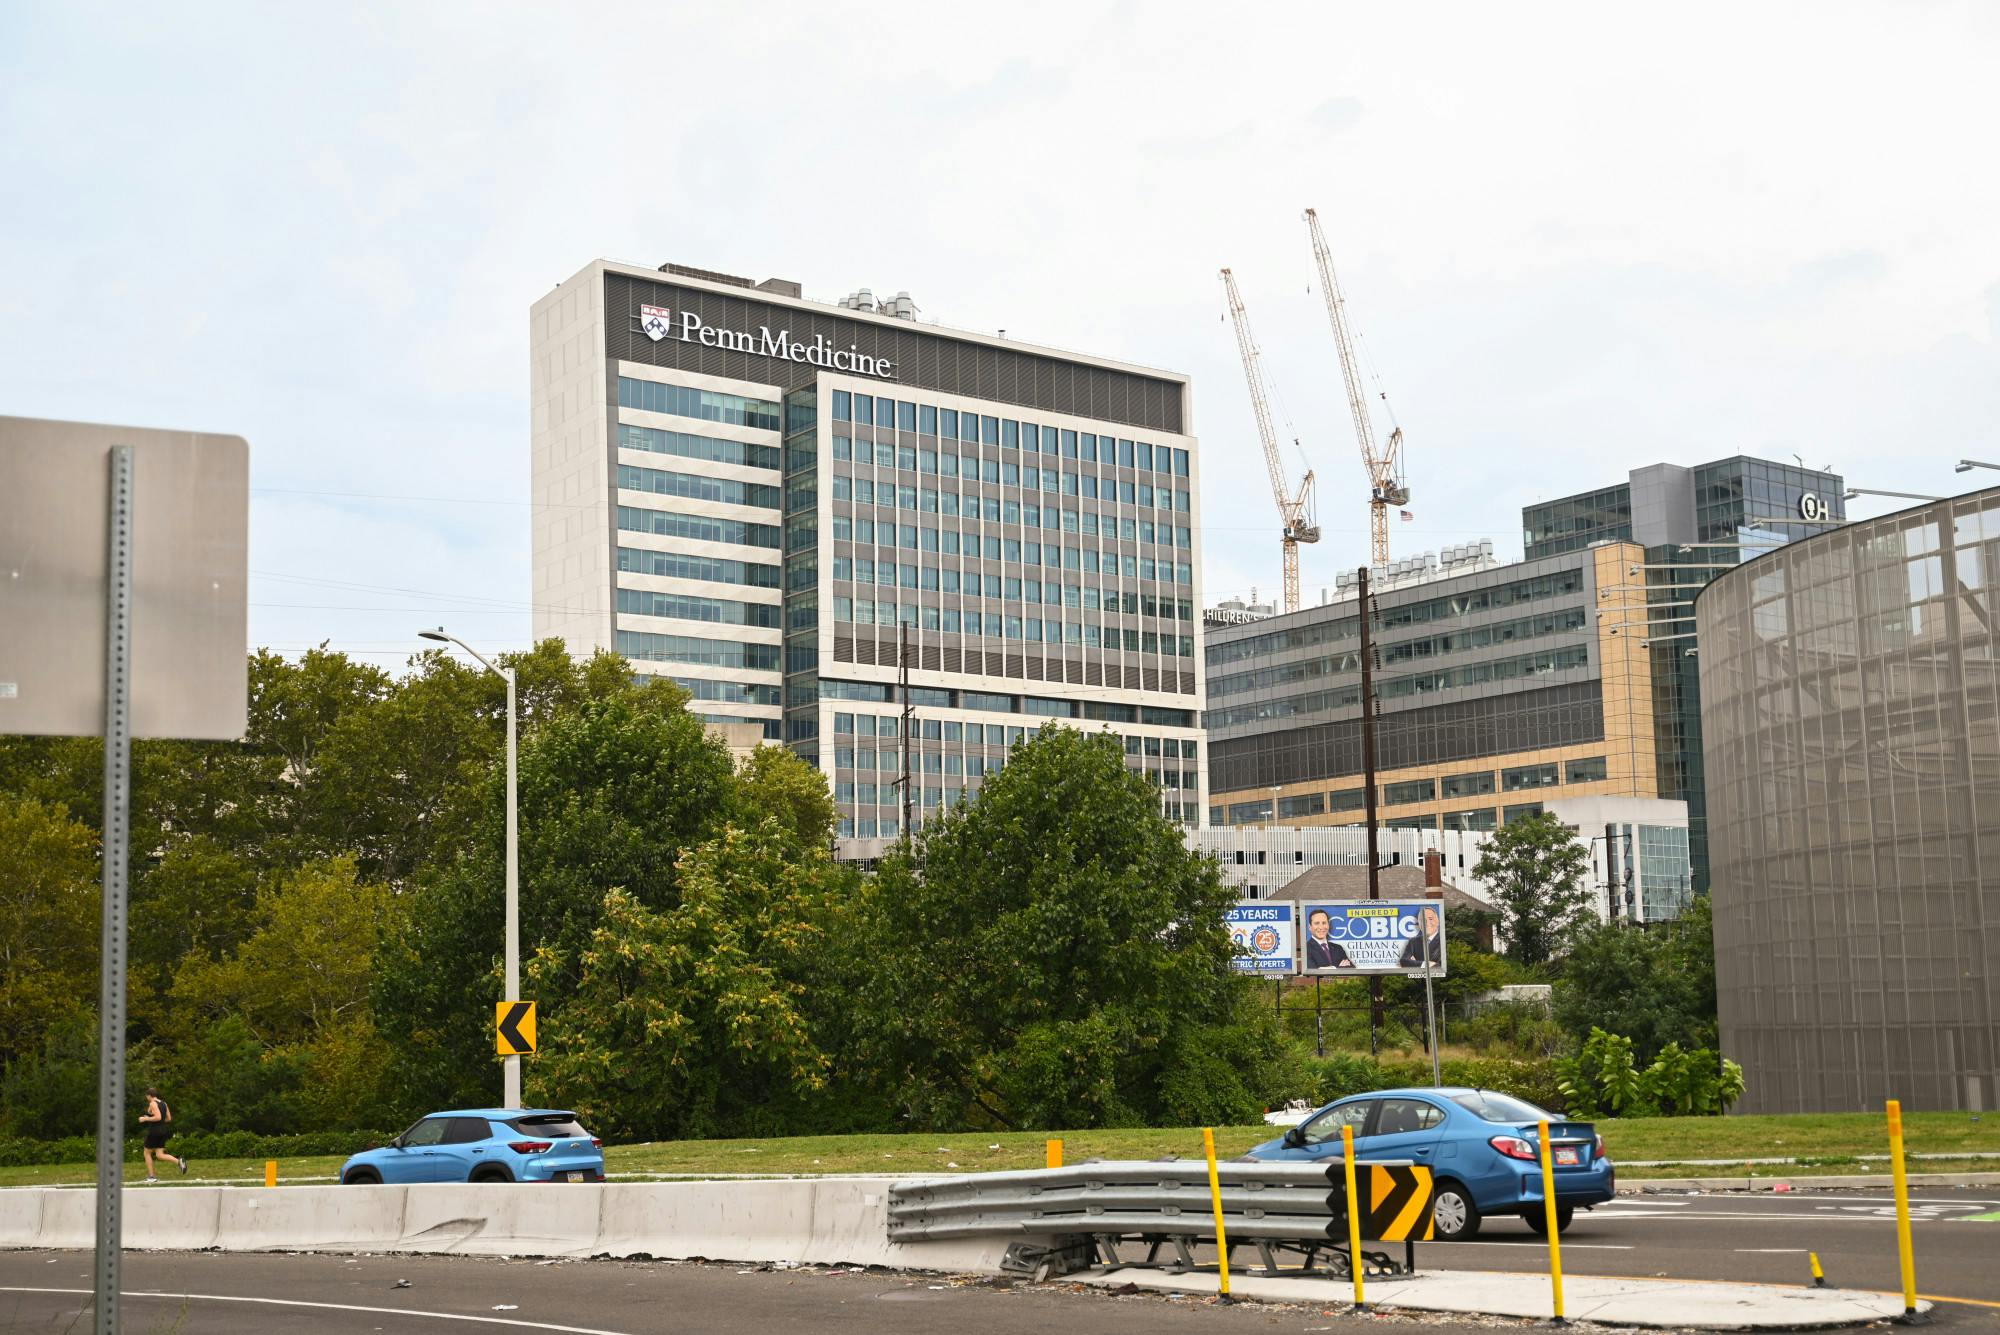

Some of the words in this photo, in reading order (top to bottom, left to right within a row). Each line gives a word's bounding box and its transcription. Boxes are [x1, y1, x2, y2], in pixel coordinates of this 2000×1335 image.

[680, 311, 755, 354] Penn
[759, 326, 892, 378] Medicine
[1226, 910, 1240, 920] 25
[1241, 909, 1279, 920] YEARS!
[1351, 908, 1395, 916] INJURED?
[1328, 916, 1370, 939] GO
[1370, 915, 1420, 939] BIG
[1258, 932, 1273, 944] 25
[1347, 941, 1389, 950] GILMAN
[1391, 941, 1400, 950] &
[1349, 950, 1401, 959] BEDIGIAN
[1253, 960, 1286, 968] EXPERTS
